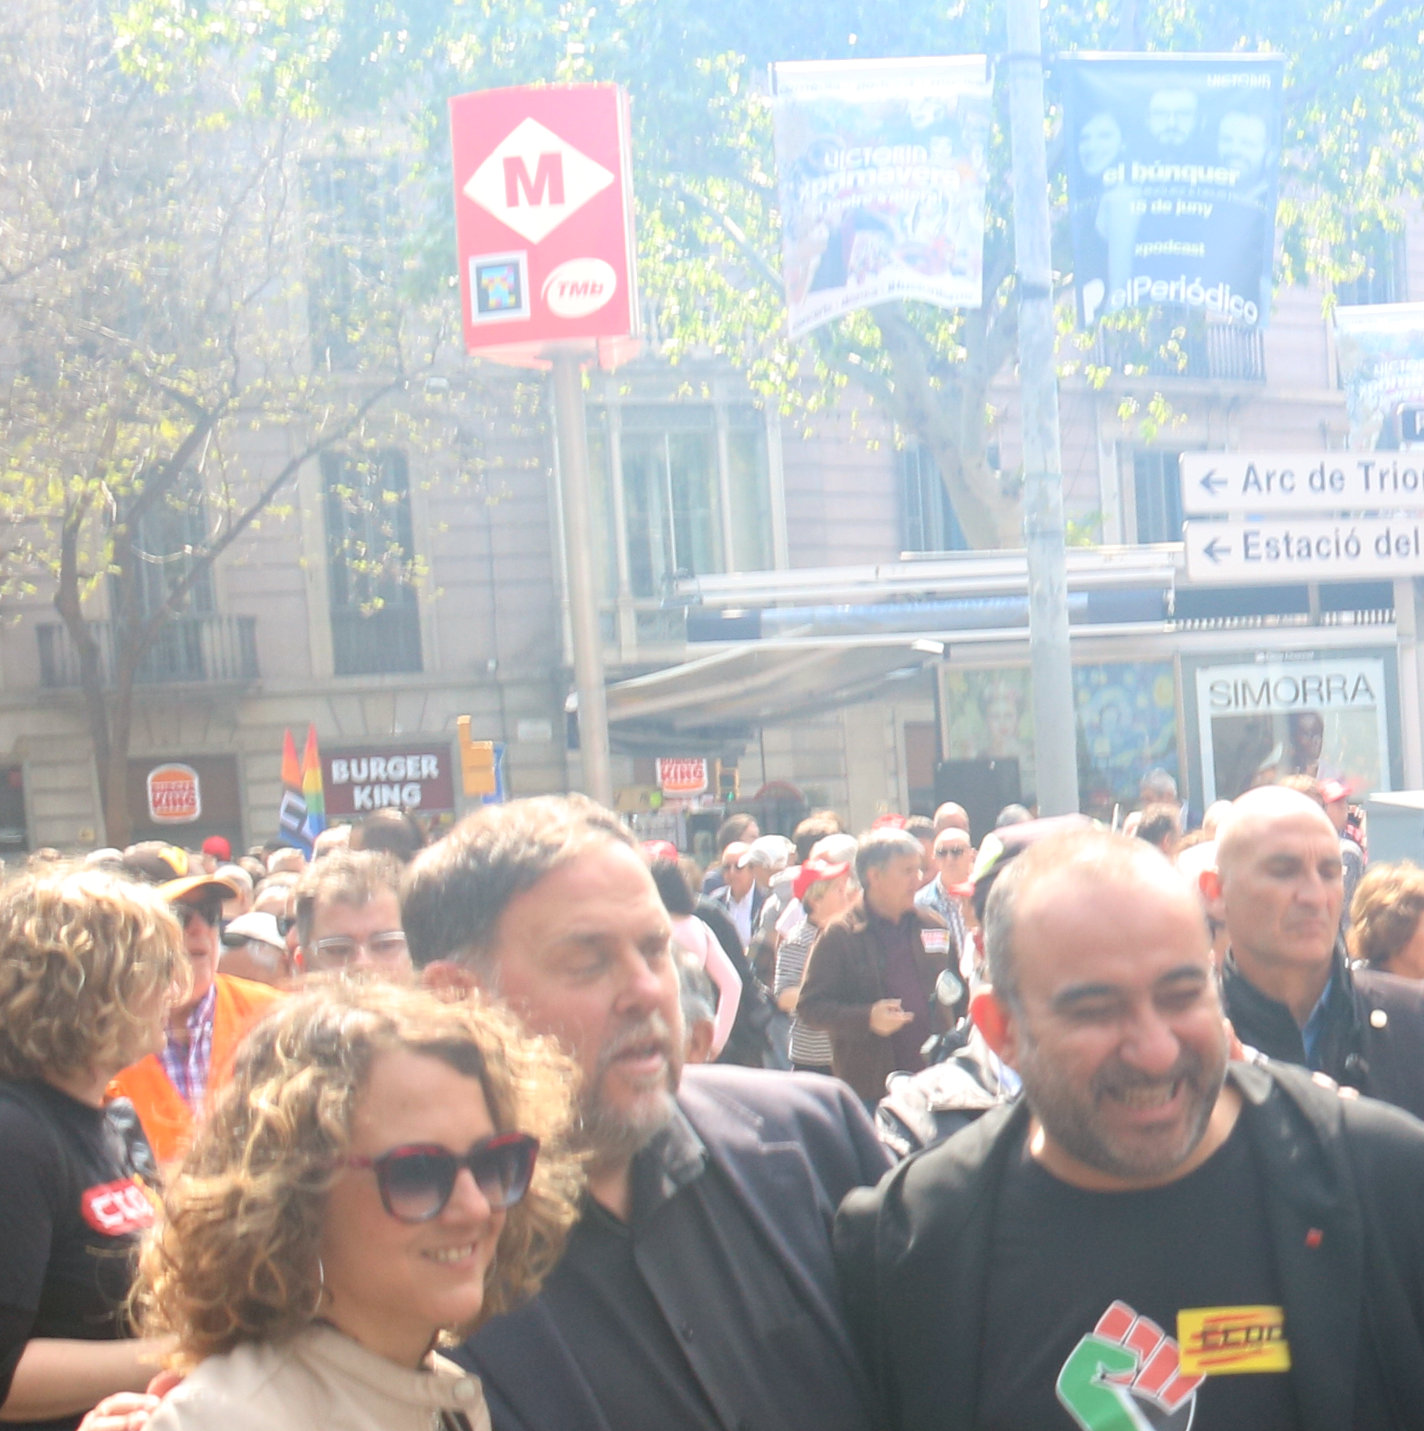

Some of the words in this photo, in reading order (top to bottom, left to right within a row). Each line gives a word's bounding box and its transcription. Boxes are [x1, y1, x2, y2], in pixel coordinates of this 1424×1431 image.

[502, 152, 566, 208] M
[1103, 162, 1125, 184] el
[1131, 159, 1240, 186] búnquer
[1151, 198, 1173, 216] de
[1242, 460, 1296, 493] Arc
[1308, 460, 1346, 492] de
[1243, 526, 1361, 562] Estació
[1373, 526, 1419, 558] del
[1209, 672, 1377, 710] SIMORRA
[330, 754, 441, 785] BURGER
[353, 782, 423, 812] KING
